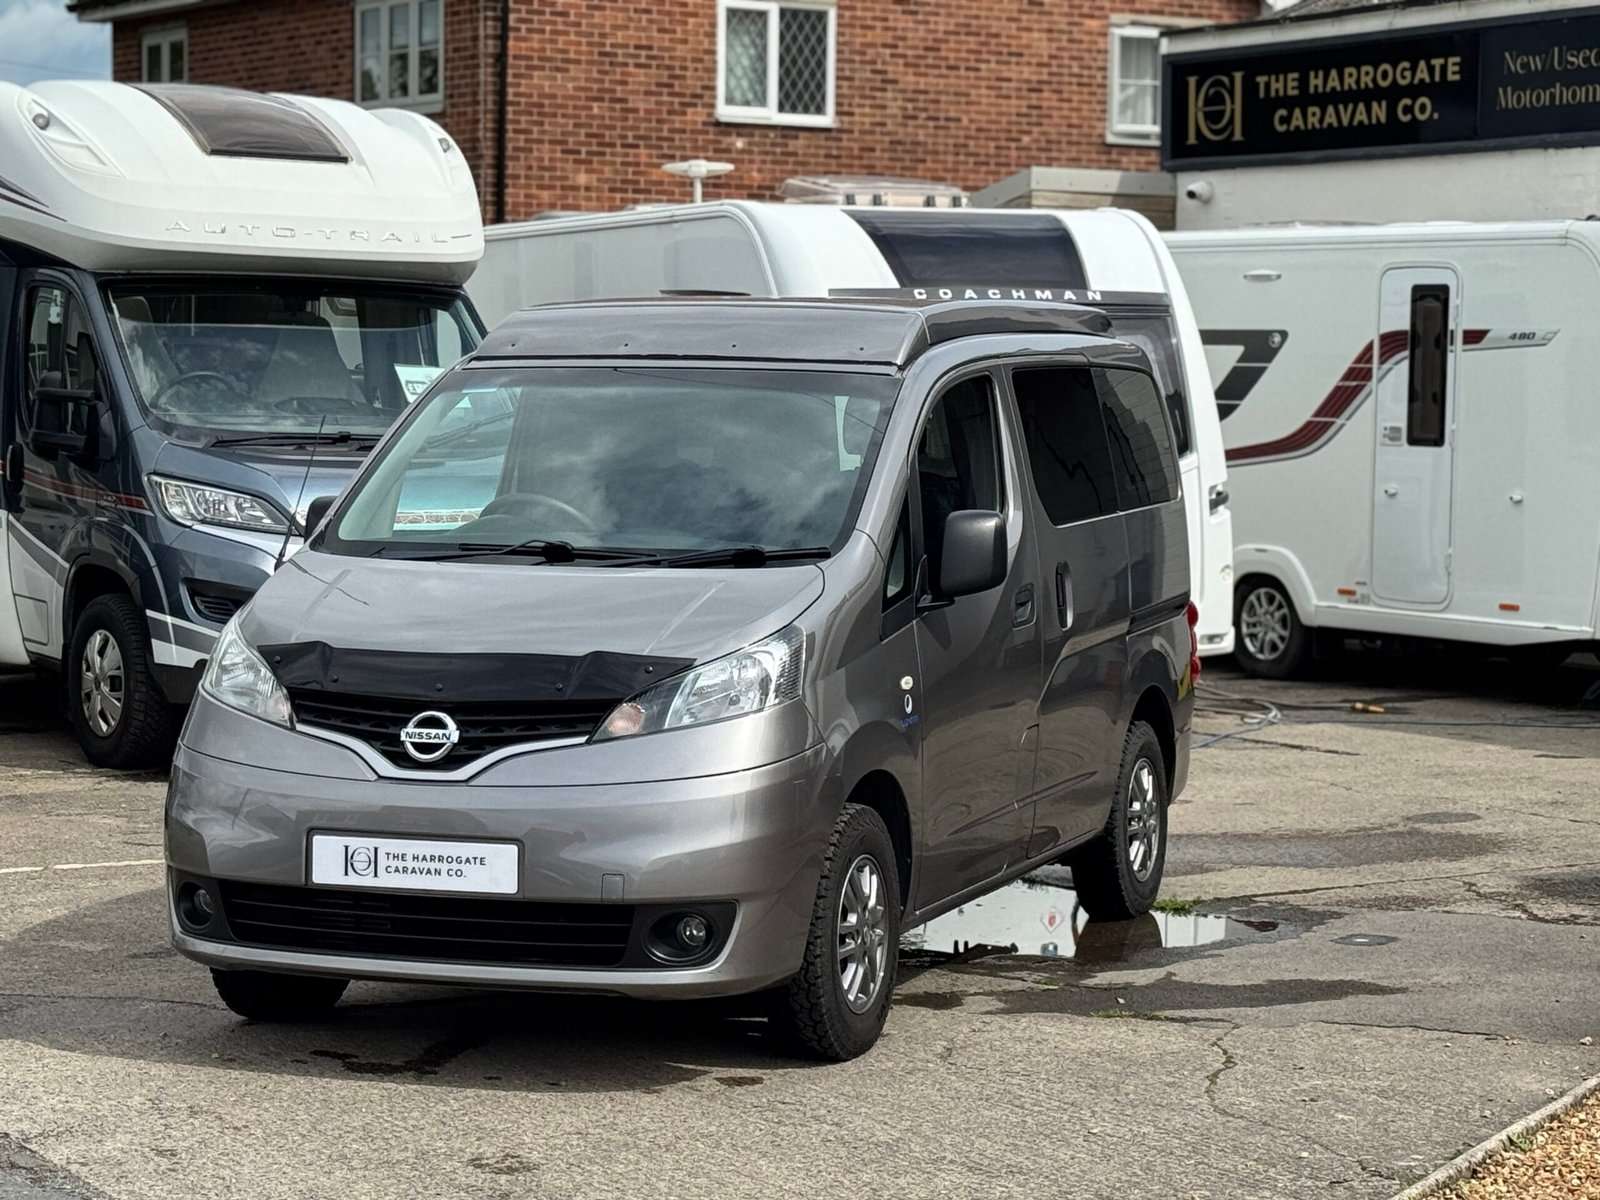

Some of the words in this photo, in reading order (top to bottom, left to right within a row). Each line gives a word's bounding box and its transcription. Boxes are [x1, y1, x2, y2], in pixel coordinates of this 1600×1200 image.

[1256, 72, 1300, 98] THE
[1309, 56, 1462, 94] HARROGATE
[1273, 100, 1387, 132] CARAVAN
[1397, 96, 1440, 122] CO.
[914, 288, 1102, 301] COACHMAN
[1508, 331, 1537, 341] 480
[404, 731, 452, 741] NISSAN
[385, 852, 408, 862] THE
[412, 853, 487, 865] HARROGATE
[385, 865, 442, 877] CARAVAN
[446, 868, 467, 878] CO.
